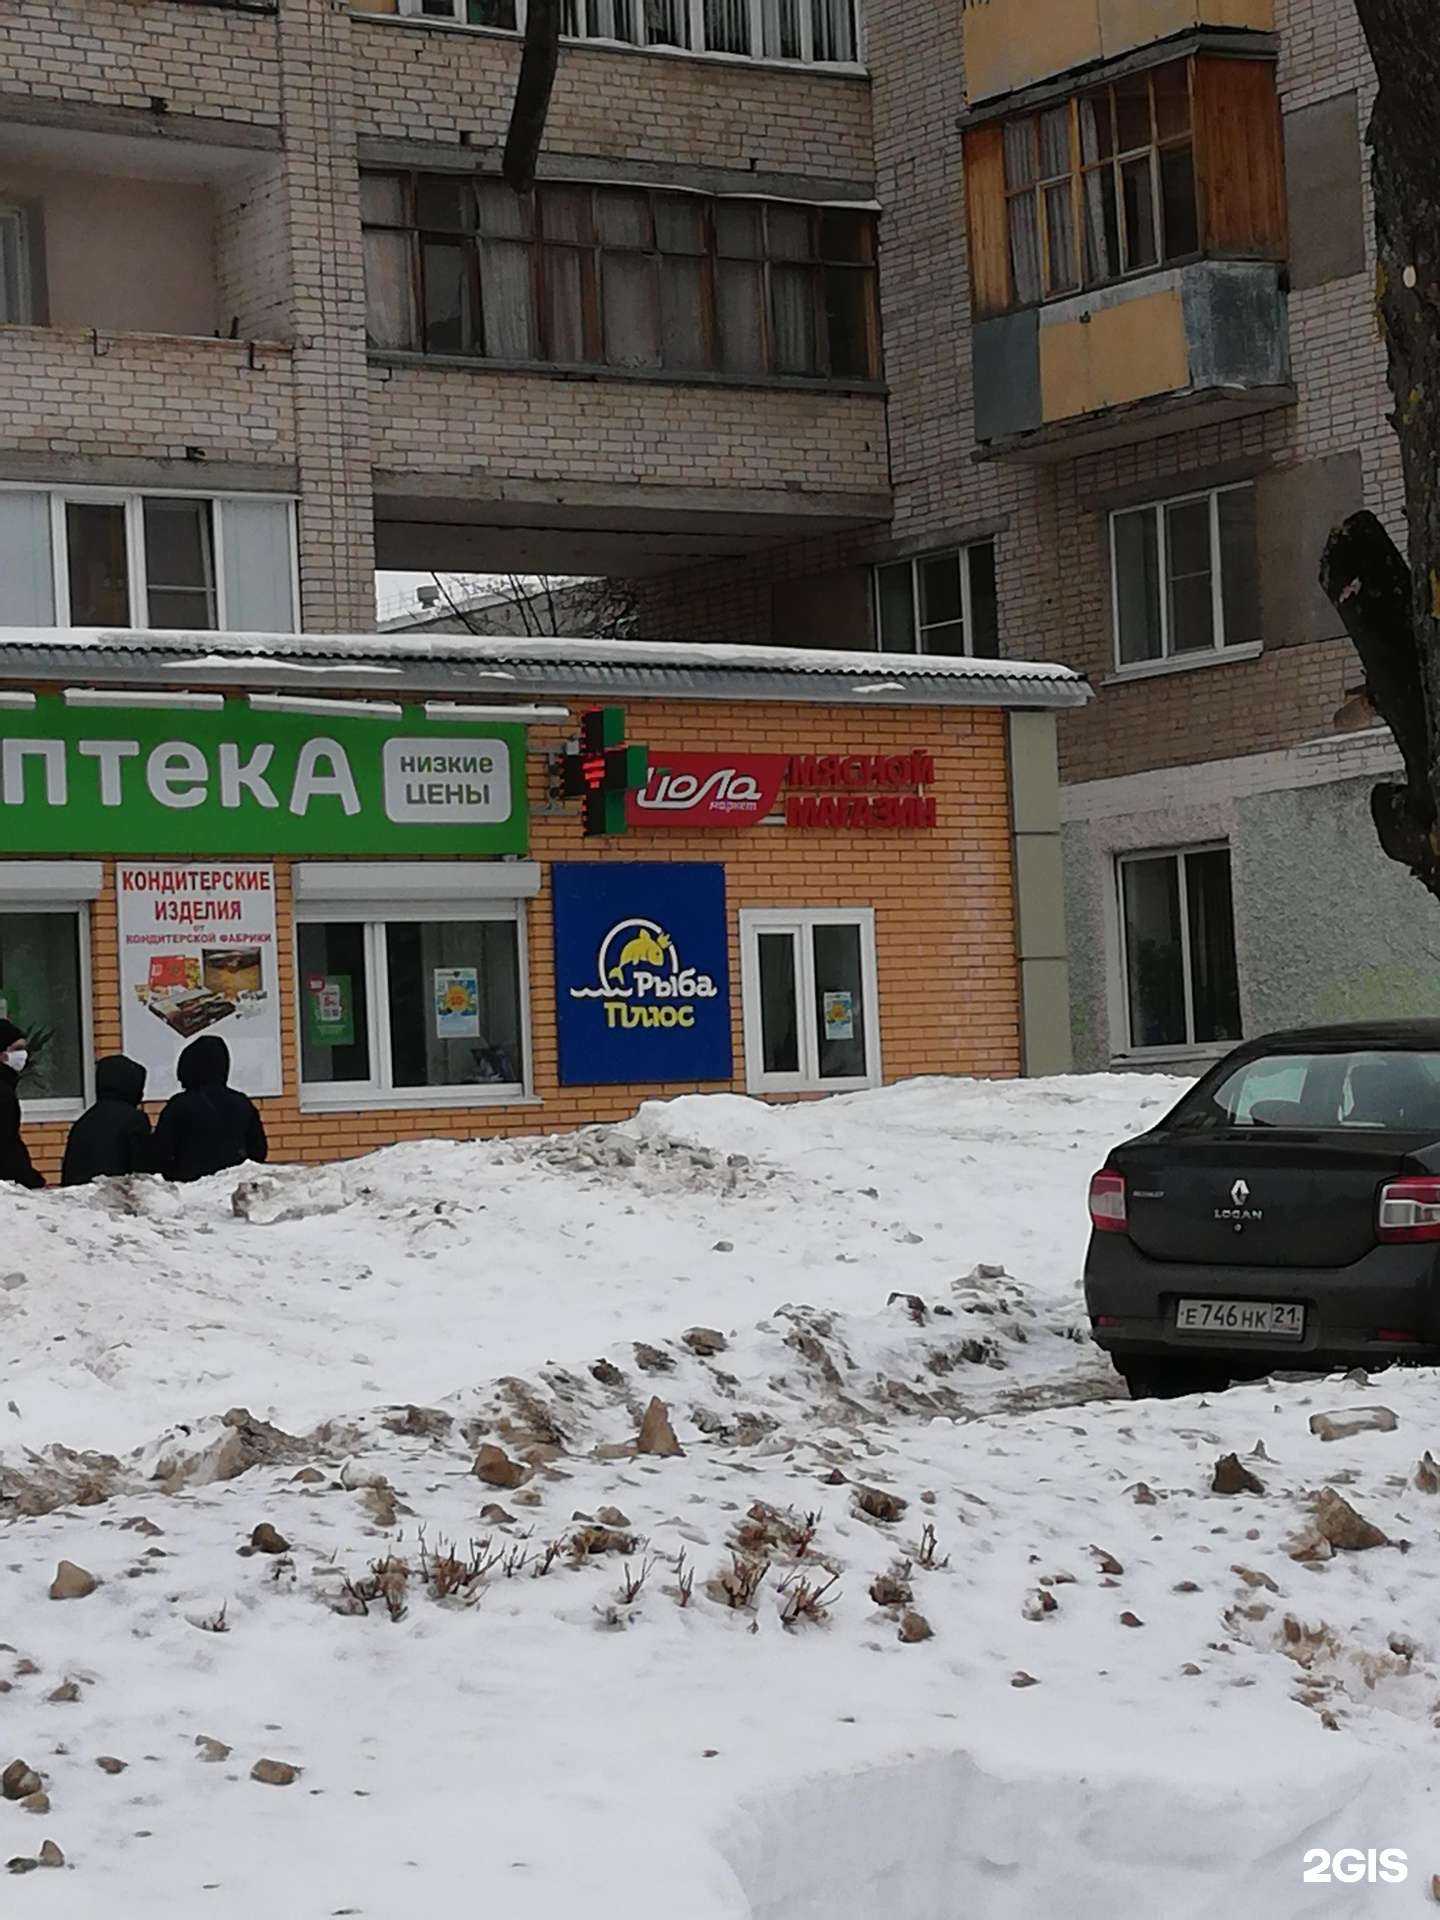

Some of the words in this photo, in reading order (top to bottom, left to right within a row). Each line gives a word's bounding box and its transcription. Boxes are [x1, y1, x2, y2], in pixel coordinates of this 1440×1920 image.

[400, 754, 494, 774] низкие
[788, 749, 935, 786] МЯСНОЙ
[405, 782, 490, 805] ЦЕНЫ
[785, 796, 937, 829] МАГАЗИН
[122, 871, 271, 894] КОНДИТЕРСКИЕ
[154, 901, 242, 924] ИЗДЕЛИЯ
[126, 934, 216, 945] КОНДИТЕРСКОЙ
[219, 934, 272, 943] ФАБРИКИ
[633, 967, 717, 998] Рыба
[604, 1002, 696, 1029] Плюс
[1214, 1208, 1263, 1220] LOGAN
